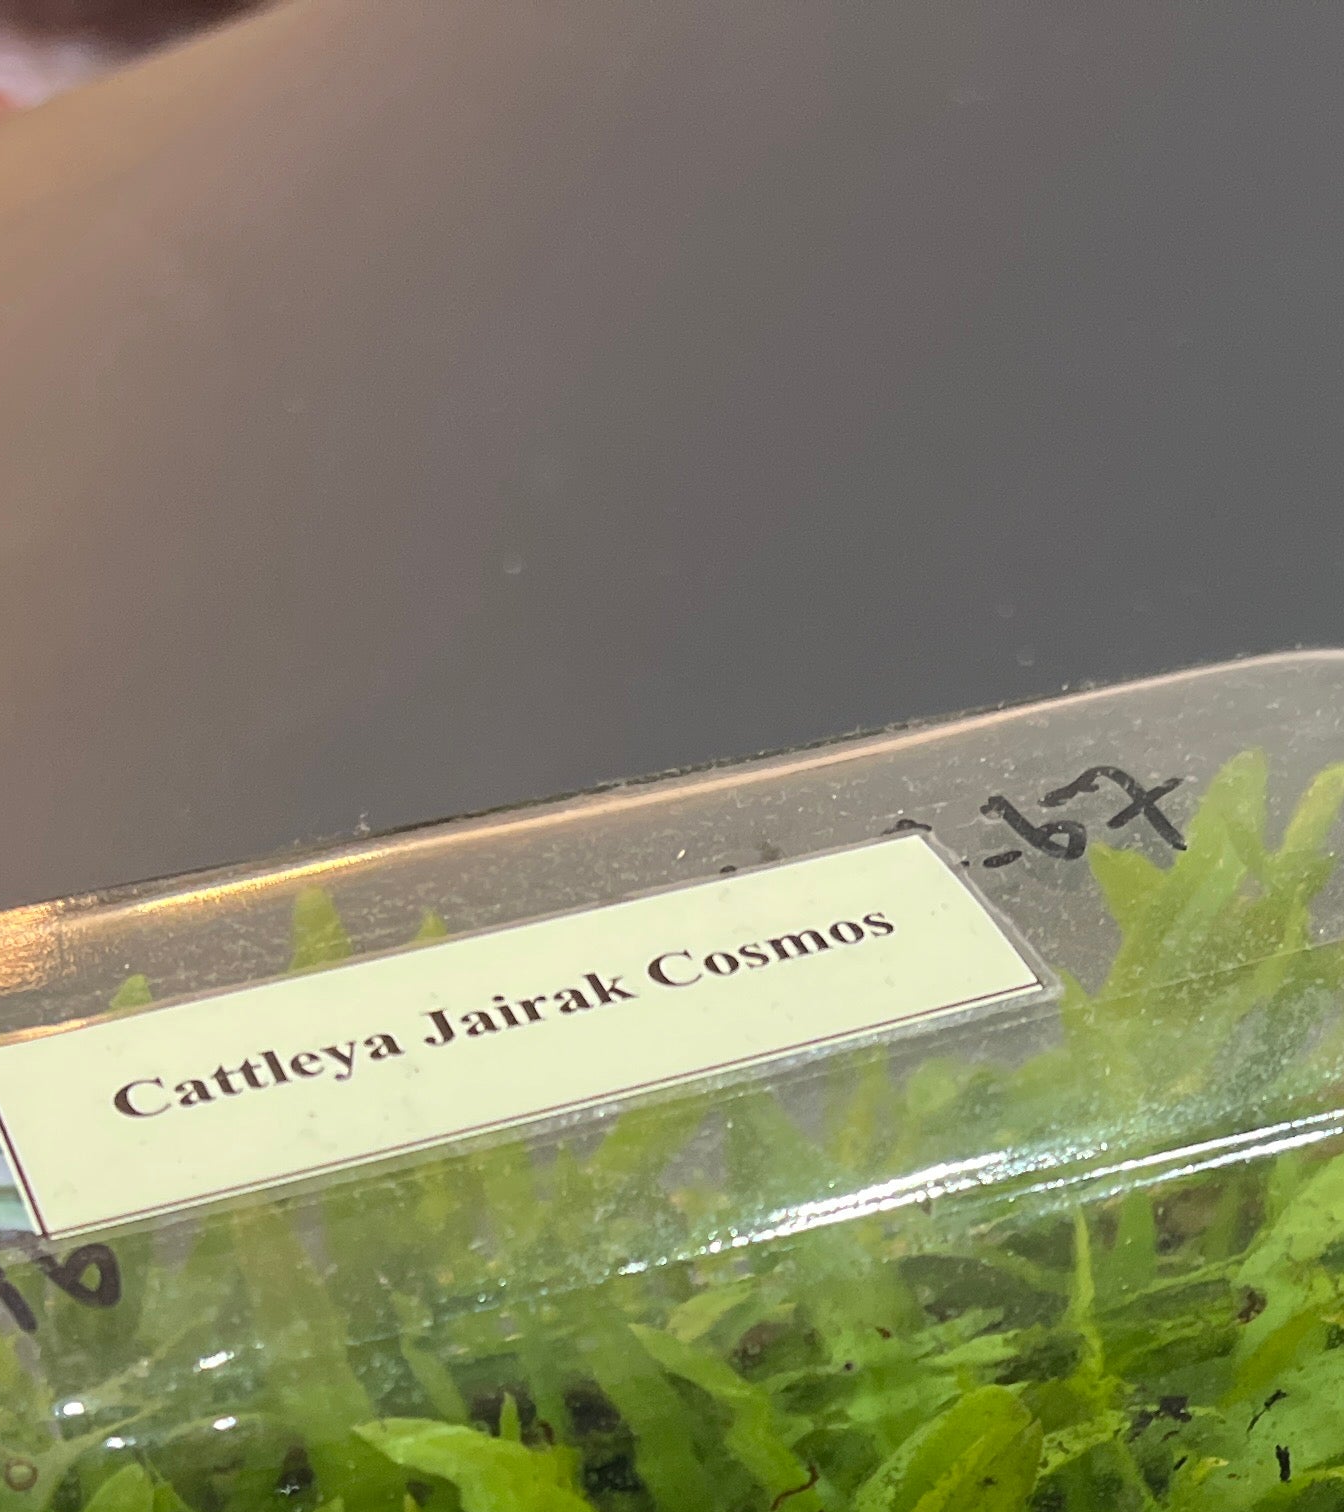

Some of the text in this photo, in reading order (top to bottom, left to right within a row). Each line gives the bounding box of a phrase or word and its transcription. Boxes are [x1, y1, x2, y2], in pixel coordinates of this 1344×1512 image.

[111, 906, 898, 1120] Cattleya Jairak Cosmos
